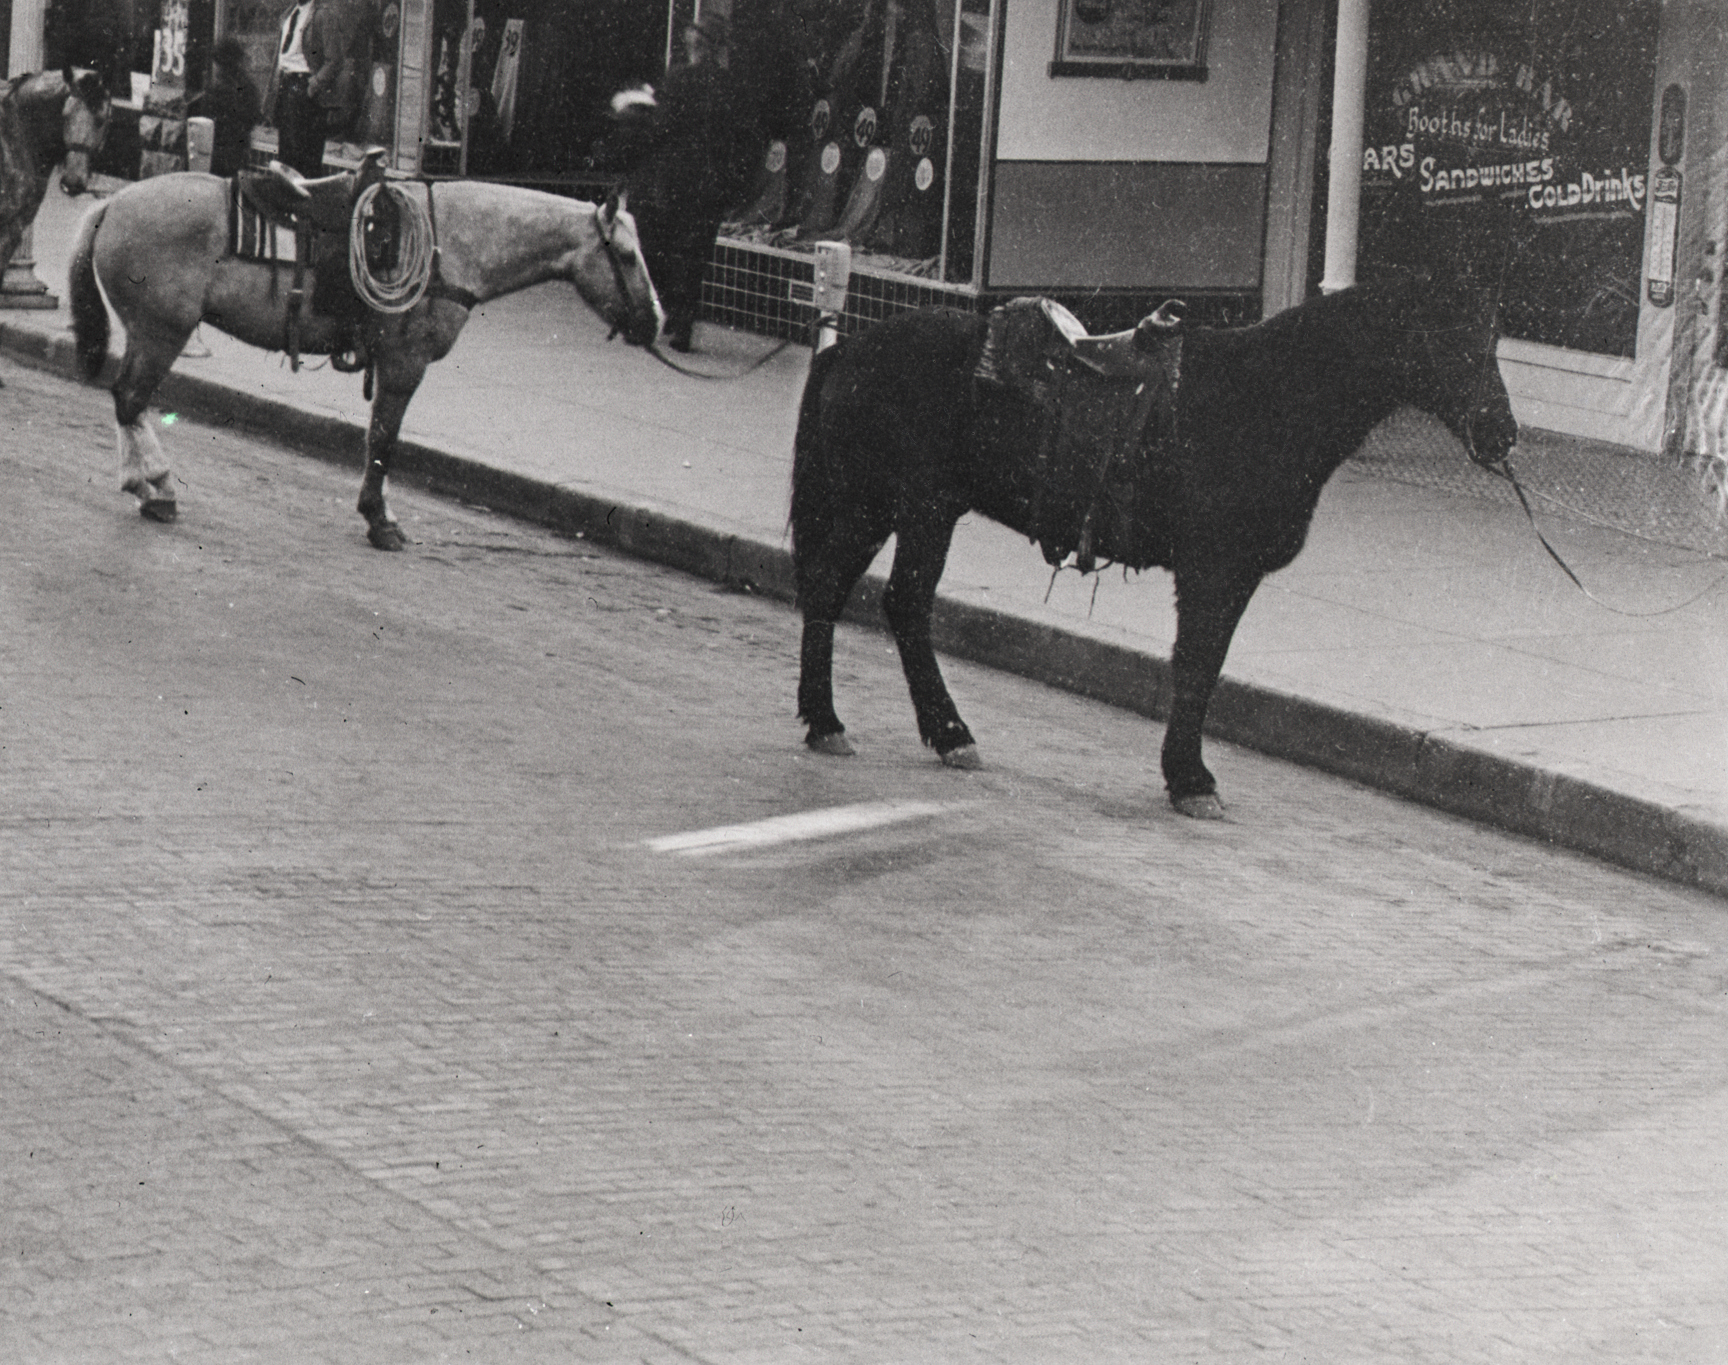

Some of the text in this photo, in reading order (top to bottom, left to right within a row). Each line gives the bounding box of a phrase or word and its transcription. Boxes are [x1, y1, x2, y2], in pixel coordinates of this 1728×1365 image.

[1405, 106, 1551, 151] Booths for Ladies
[1362, 143, 1415, 179] ARS
[1419, 155, 1554, 192] SANDWICHES
